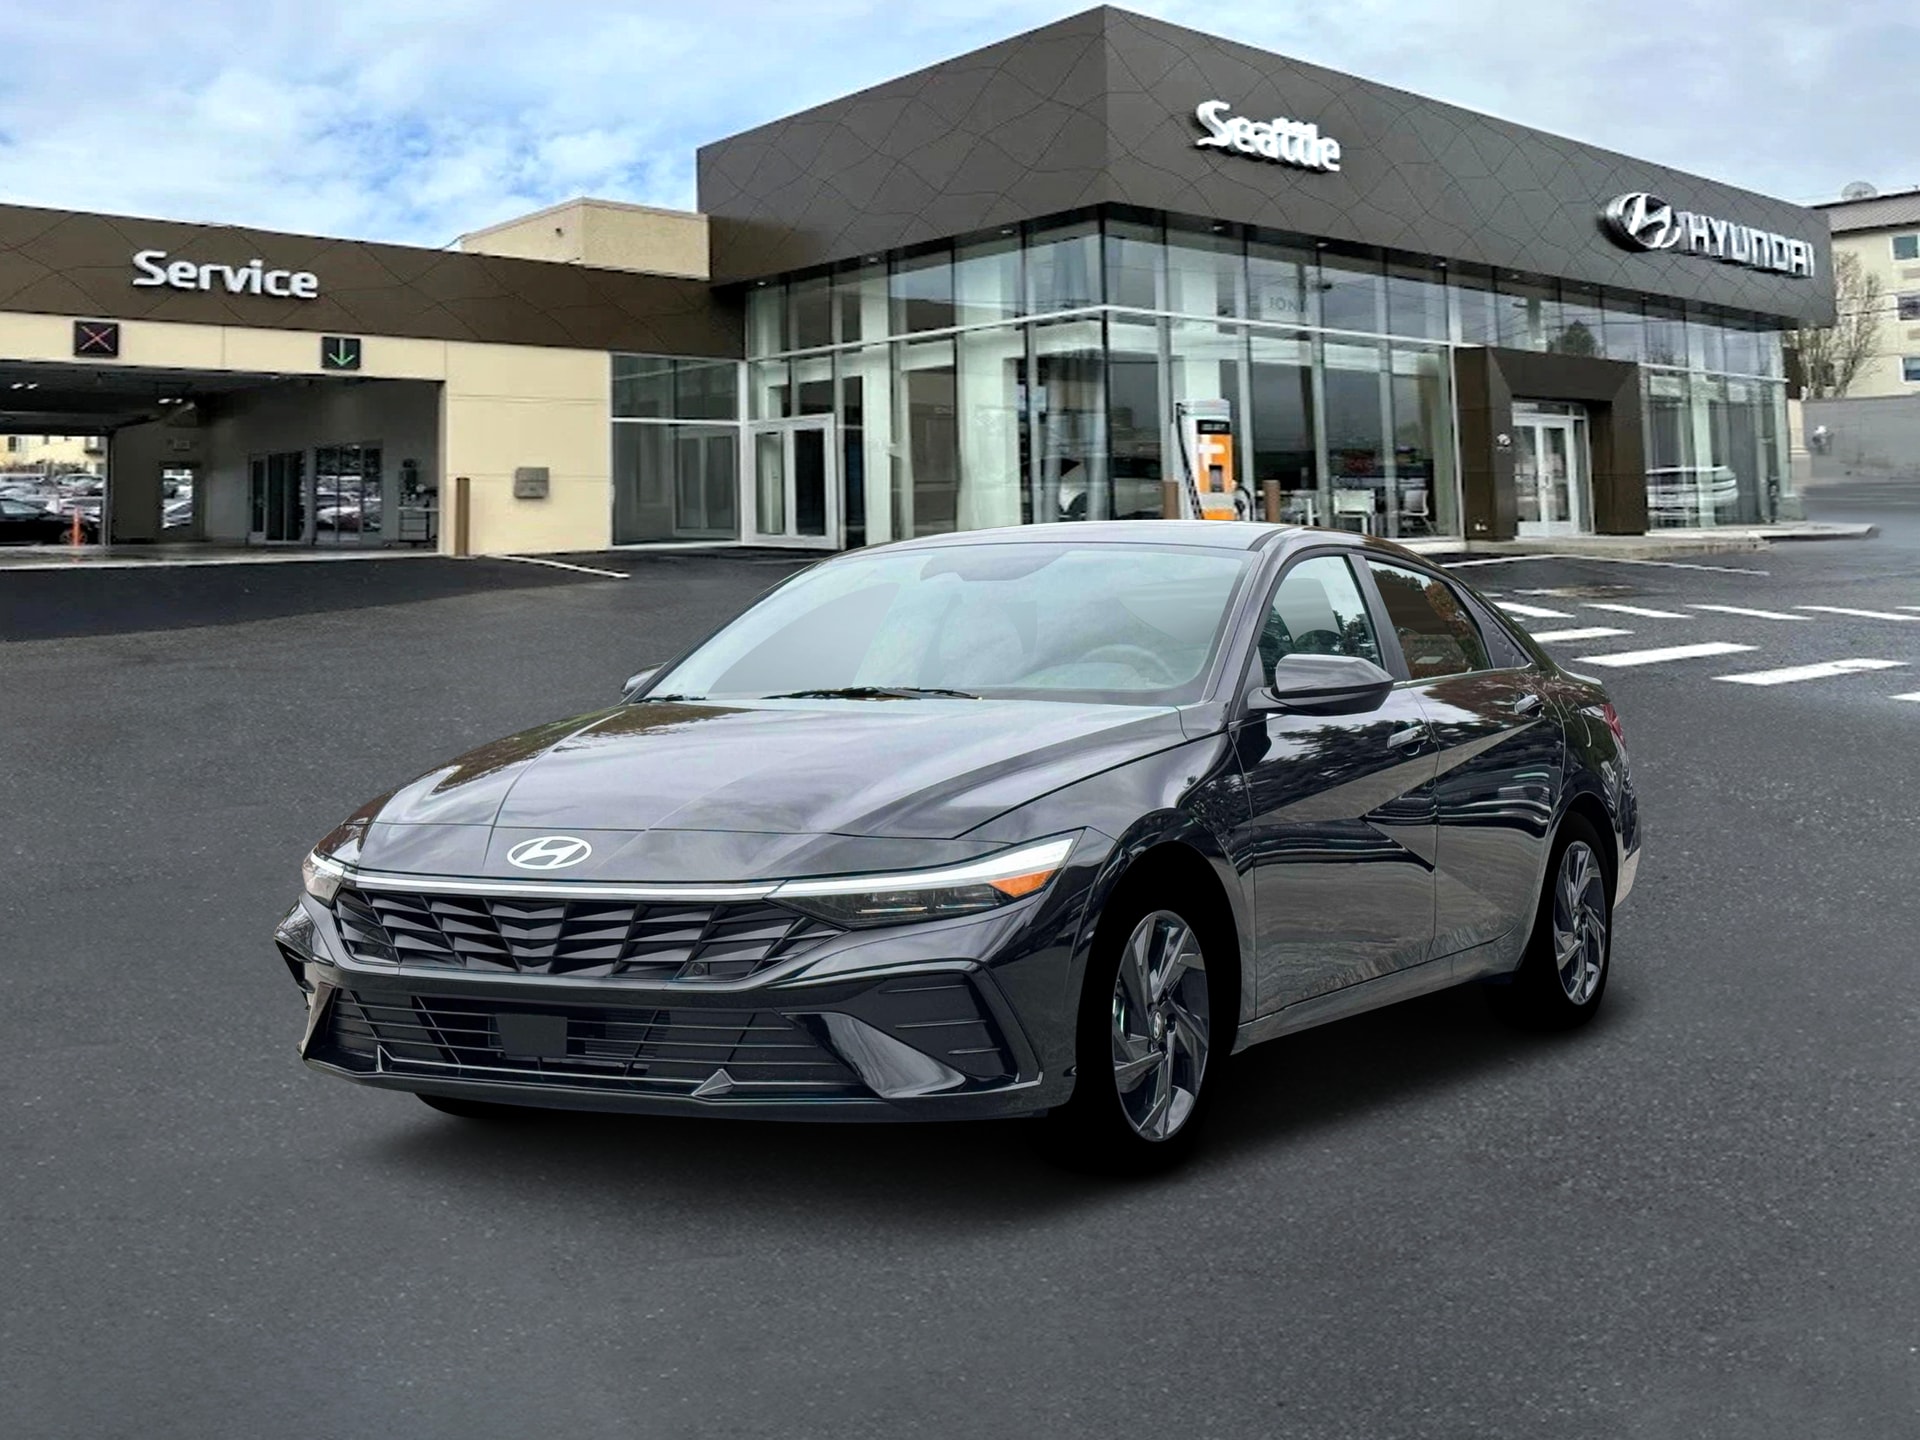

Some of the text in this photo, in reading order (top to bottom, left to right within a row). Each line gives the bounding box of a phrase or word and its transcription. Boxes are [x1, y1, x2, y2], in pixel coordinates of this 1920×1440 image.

[1196, 100, 1341, 172] Seattle
[132, 250, 319, 298] Service
[1682, 211, 1815, 278] HYUNDAI
